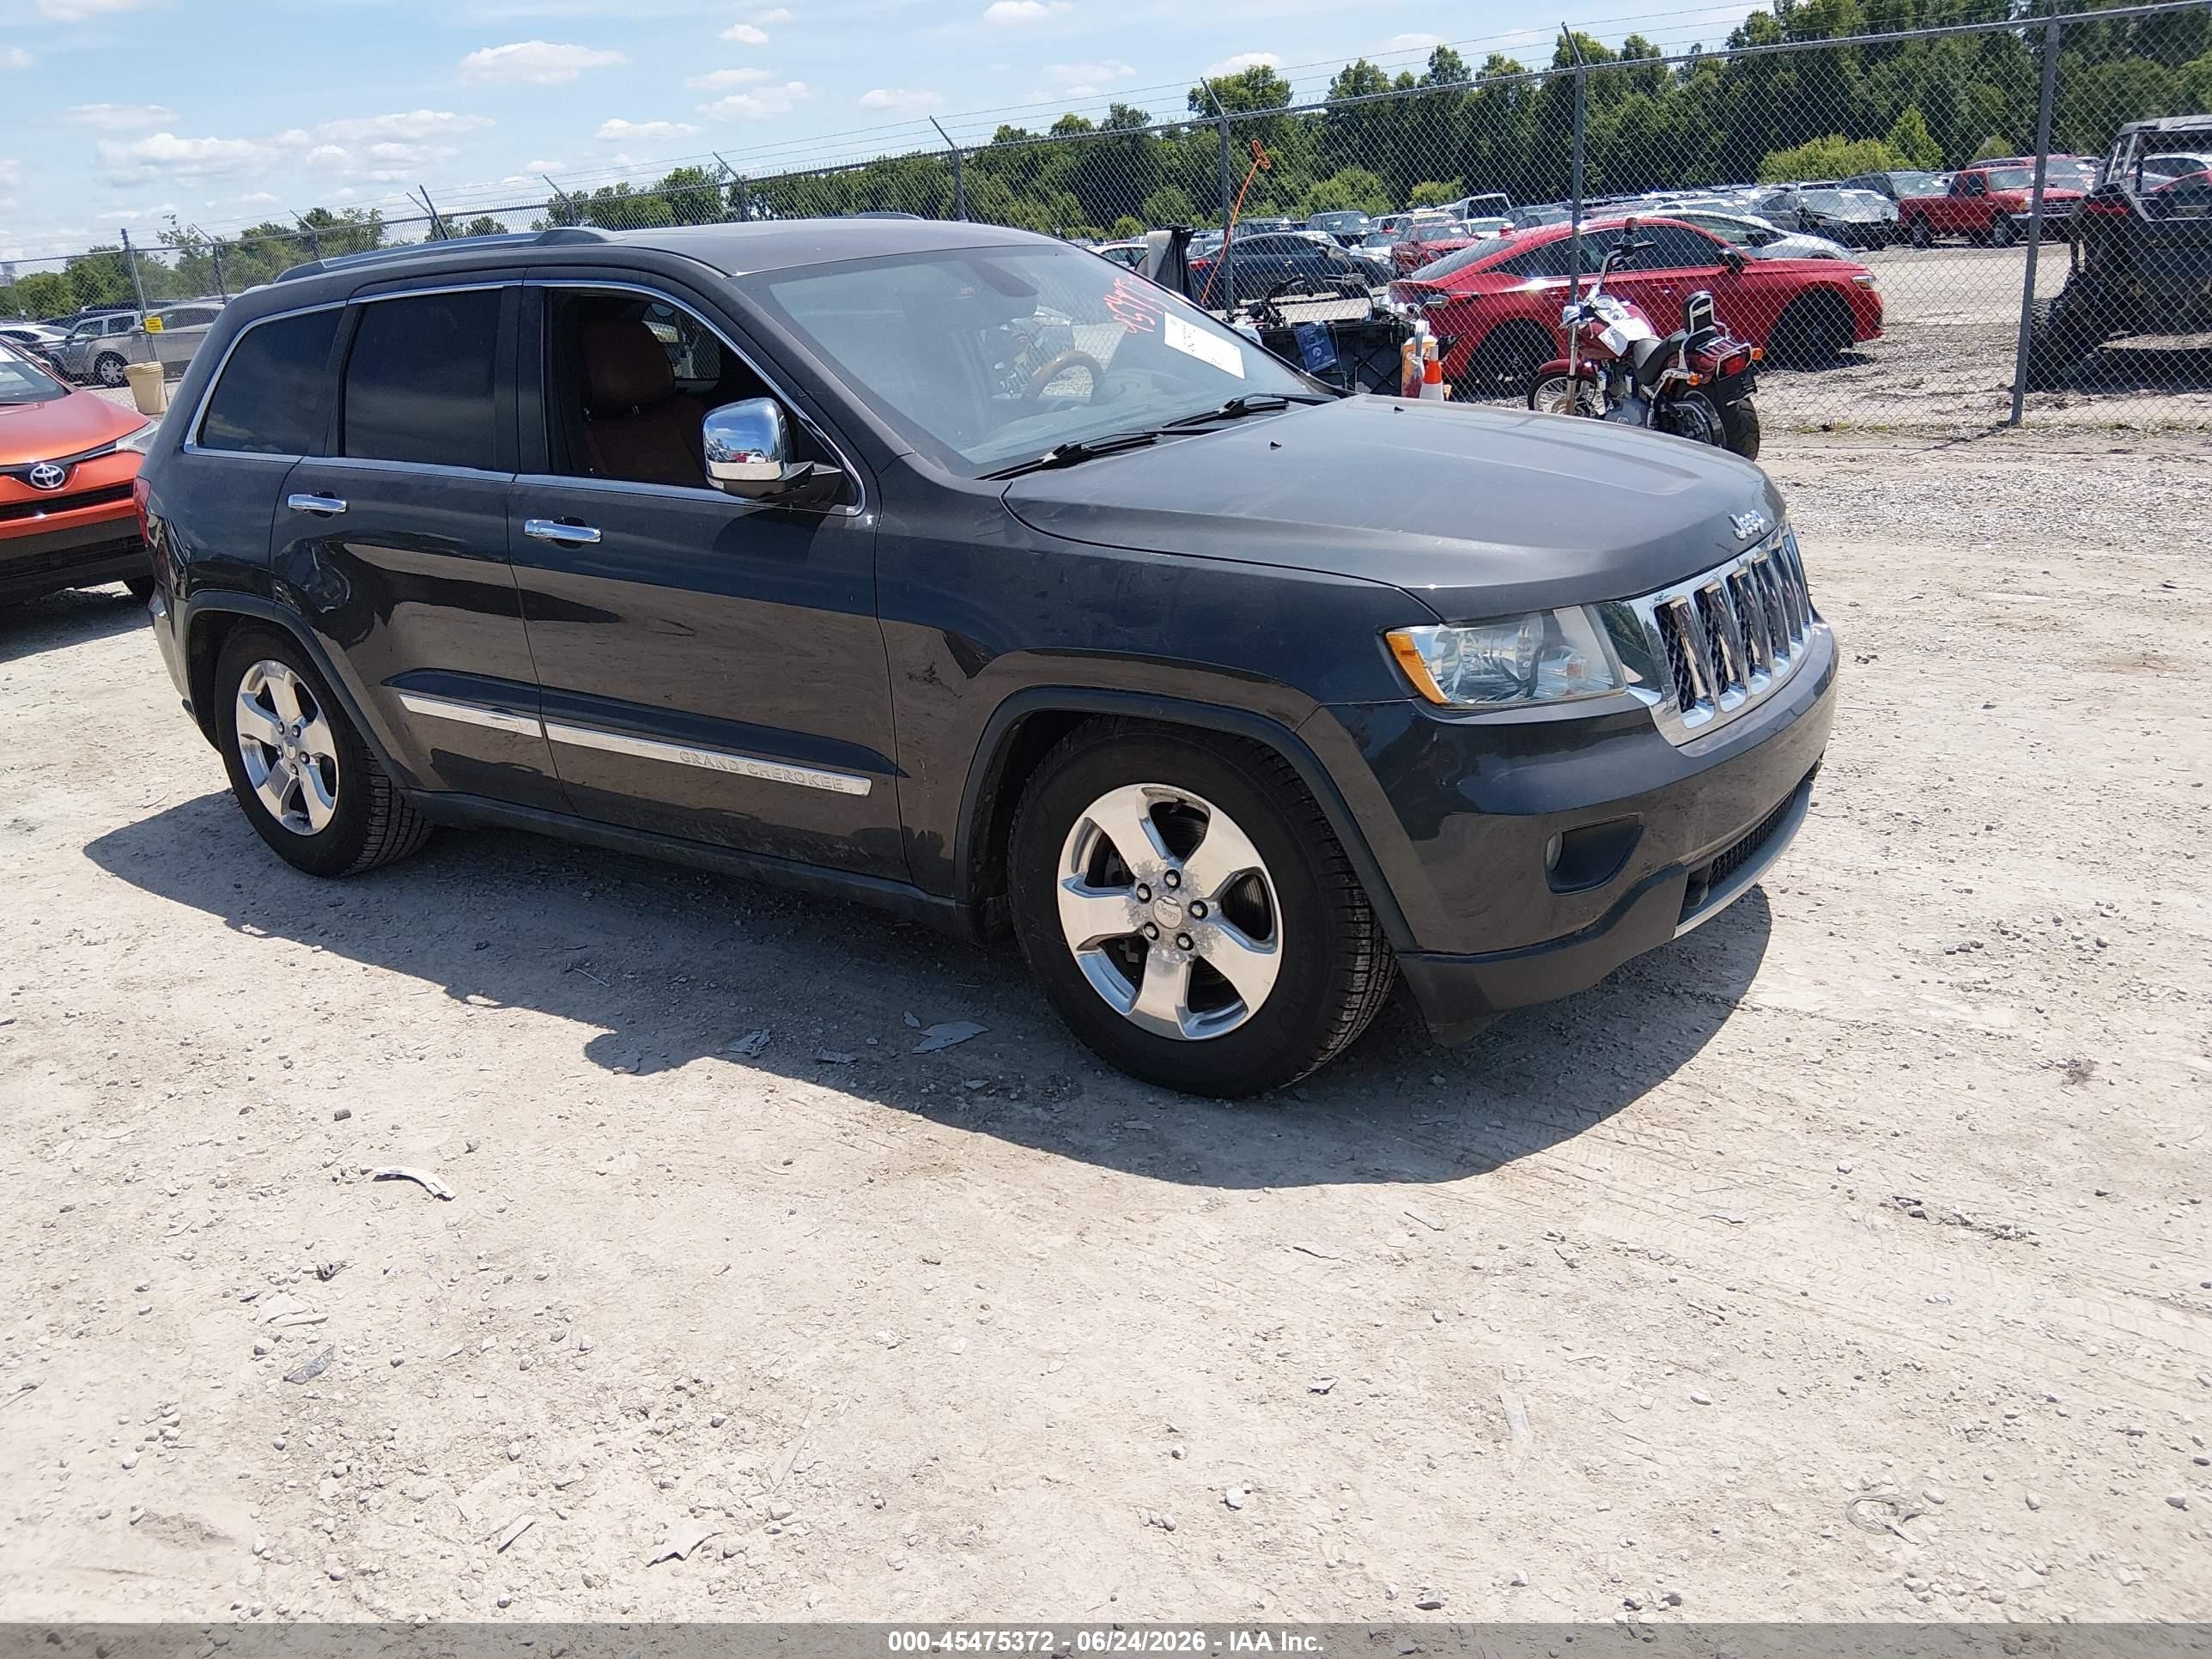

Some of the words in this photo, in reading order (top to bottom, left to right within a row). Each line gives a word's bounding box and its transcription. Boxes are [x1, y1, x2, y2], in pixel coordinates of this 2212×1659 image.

[1729, 510, 1765, 540] Jeep
[679, 750, 741, 771] GRAND
[746, 763, 844, 791] CHEROKEE
